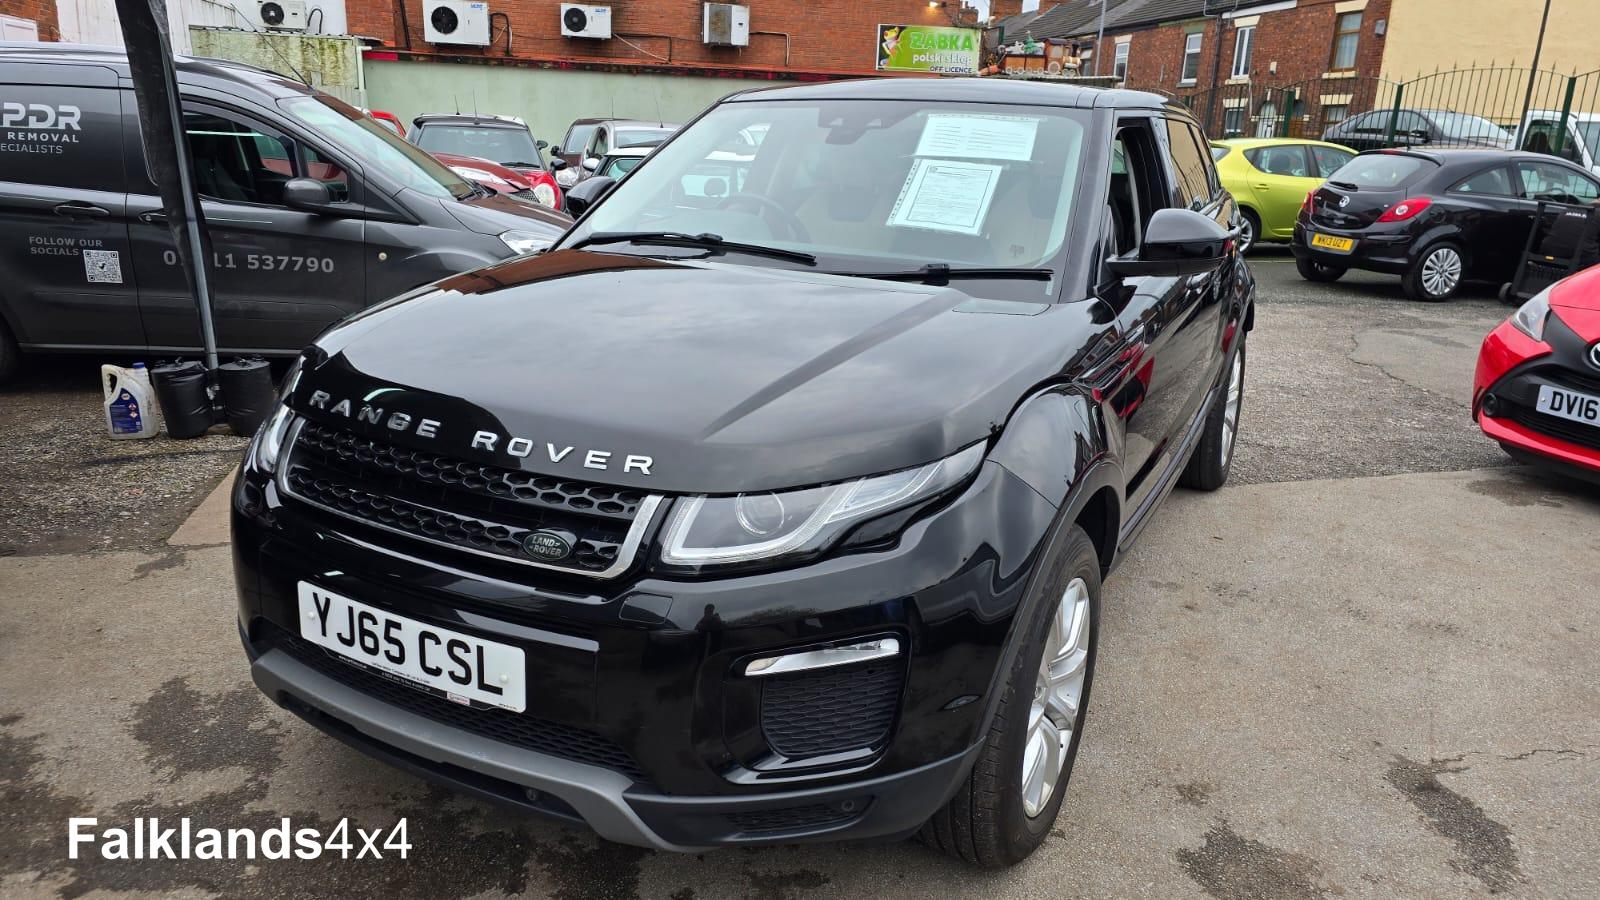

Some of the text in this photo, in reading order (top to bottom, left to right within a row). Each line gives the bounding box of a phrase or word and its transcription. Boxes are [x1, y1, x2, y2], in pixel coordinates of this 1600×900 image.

[912, 52, 972, 66] polski sklep
[945, 66, 973, 74] LICENCE
[2, 101, 82, 131] PDR
[7, 131, 80, 143] REMOVAL
[29, 236, 103, 247] FOLLOW OUR
[30, 247, 80, 256] SOCIALS
[247, 254, 335, 273] 537790
[1549, 390, 1600, 421] DV16
[308, 389, 653, 476] RANGE ROVER
[532, 535, 555, 547] LAND
[533, 544, 562, 557] ROVER
[312, 591, 504, 697] YJ65 CSL
